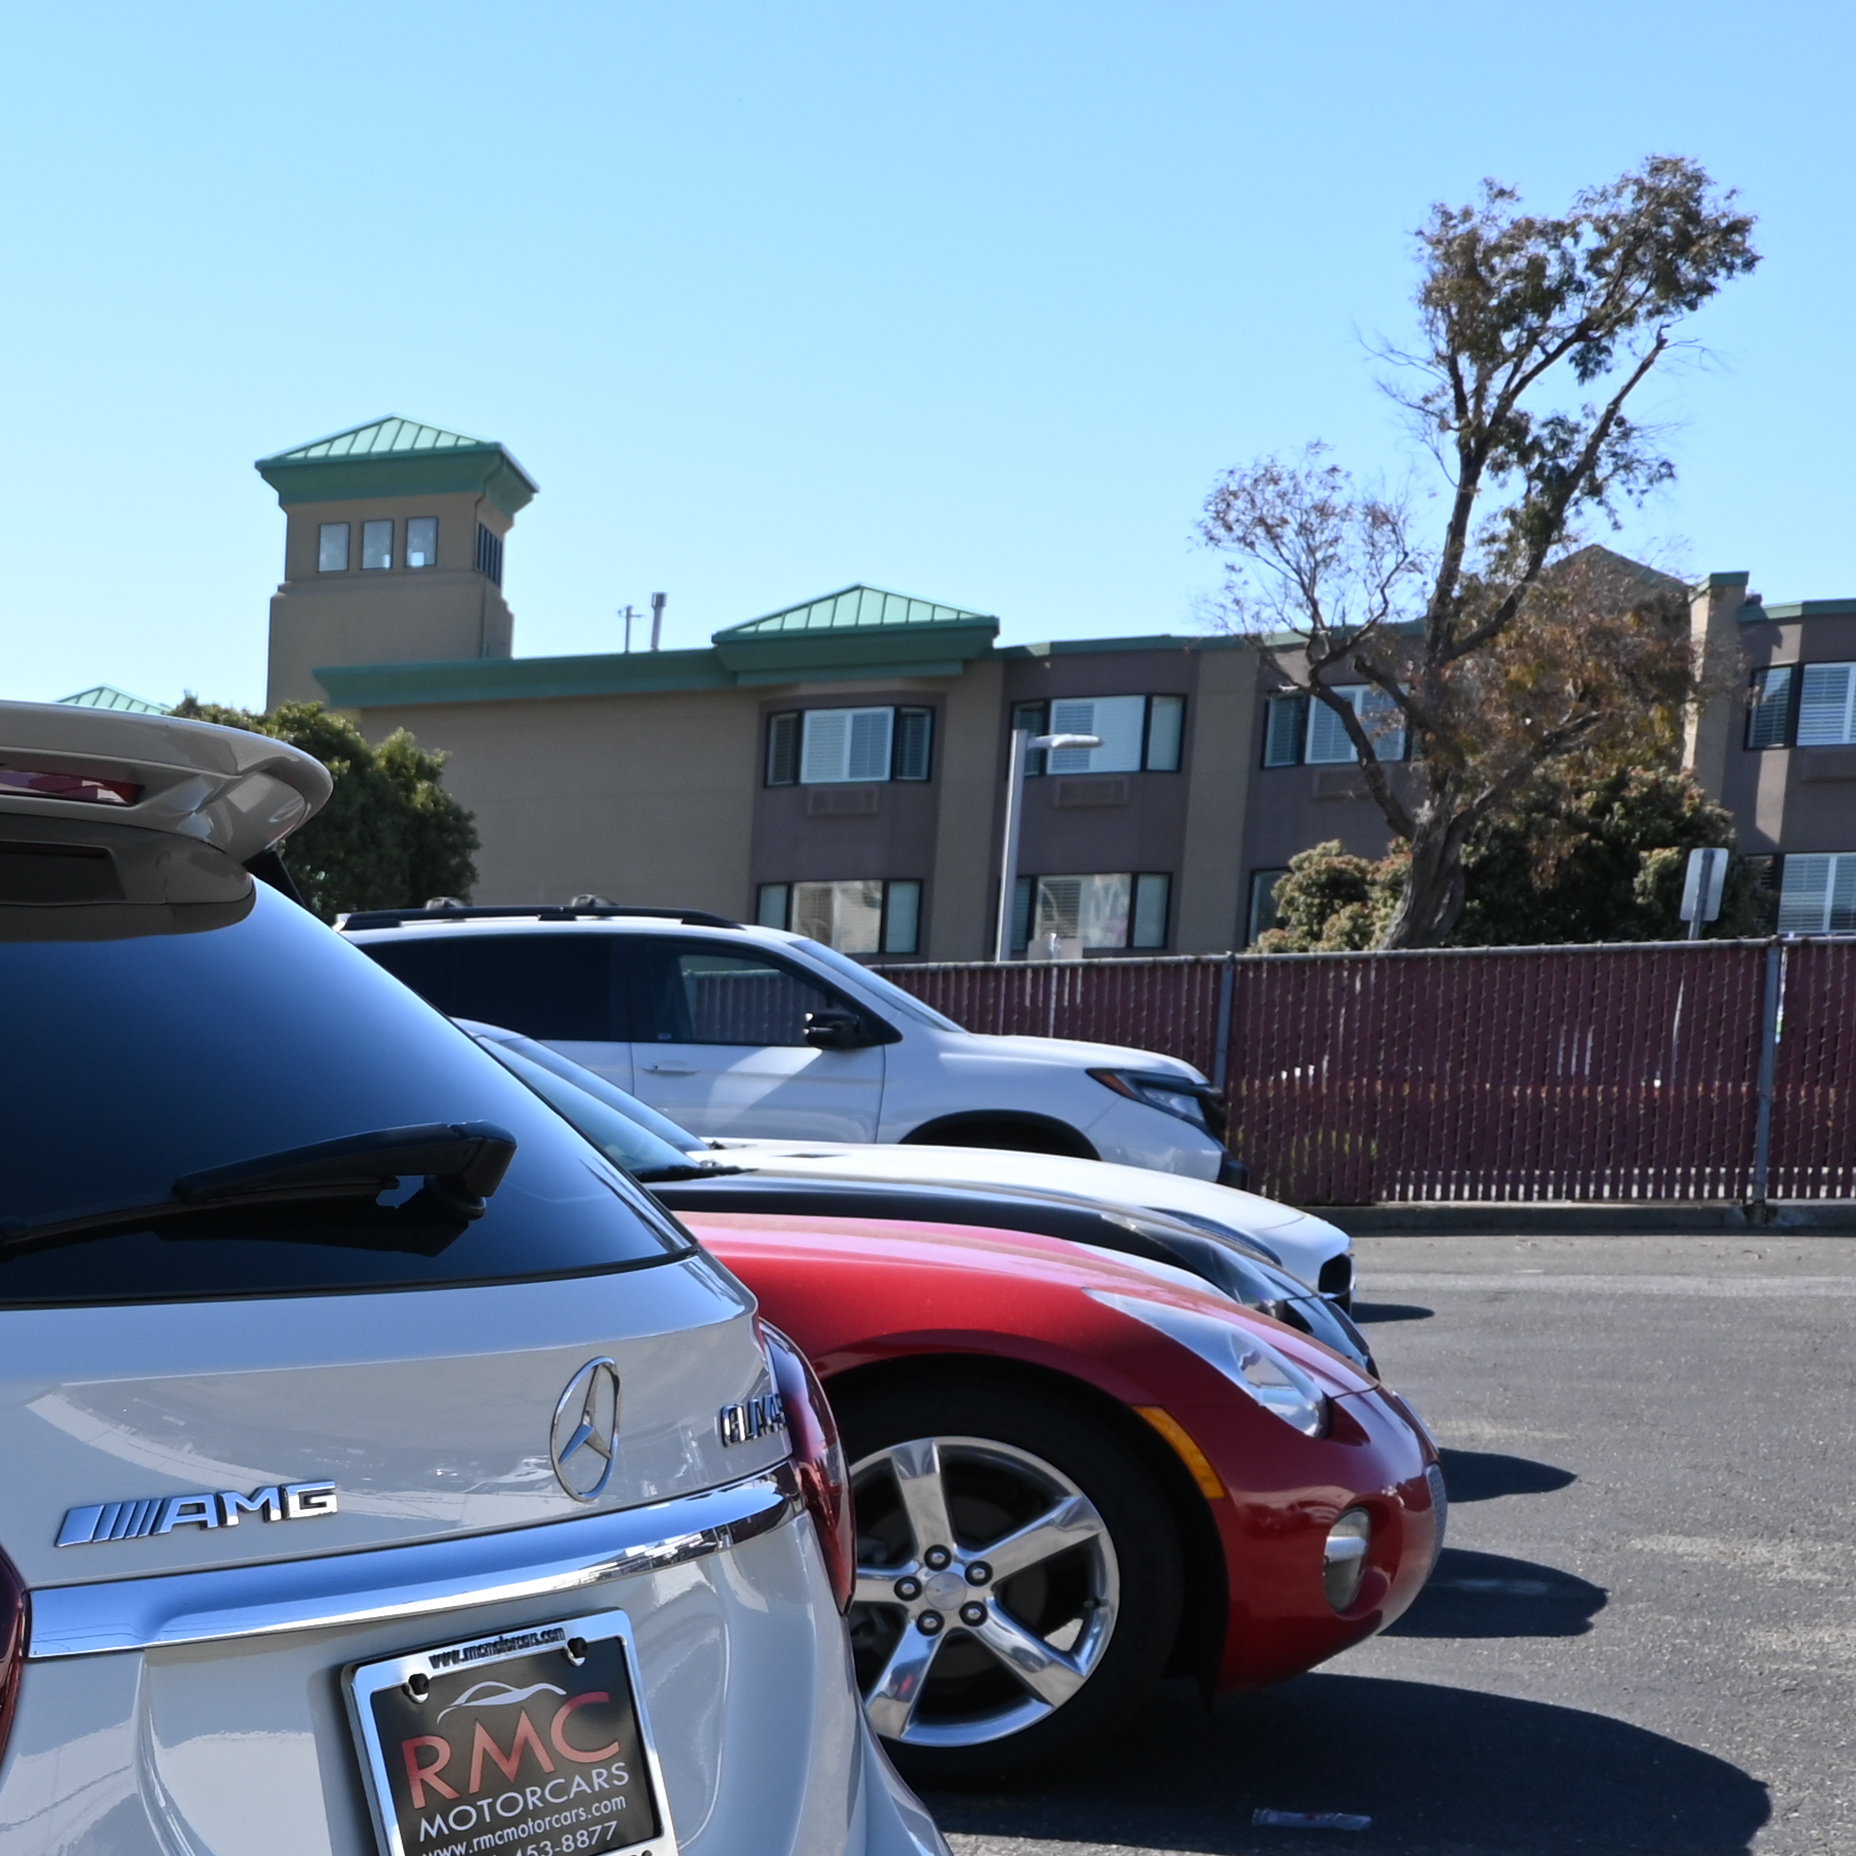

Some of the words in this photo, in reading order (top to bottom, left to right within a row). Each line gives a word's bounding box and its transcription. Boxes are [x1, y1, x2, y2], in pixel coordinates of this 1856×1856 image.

[153, 1480, 339, 1537] AMG
[401, 1691, 620, 1809] RMC
[419, 1762, 630, 1843] MOTORCARS
